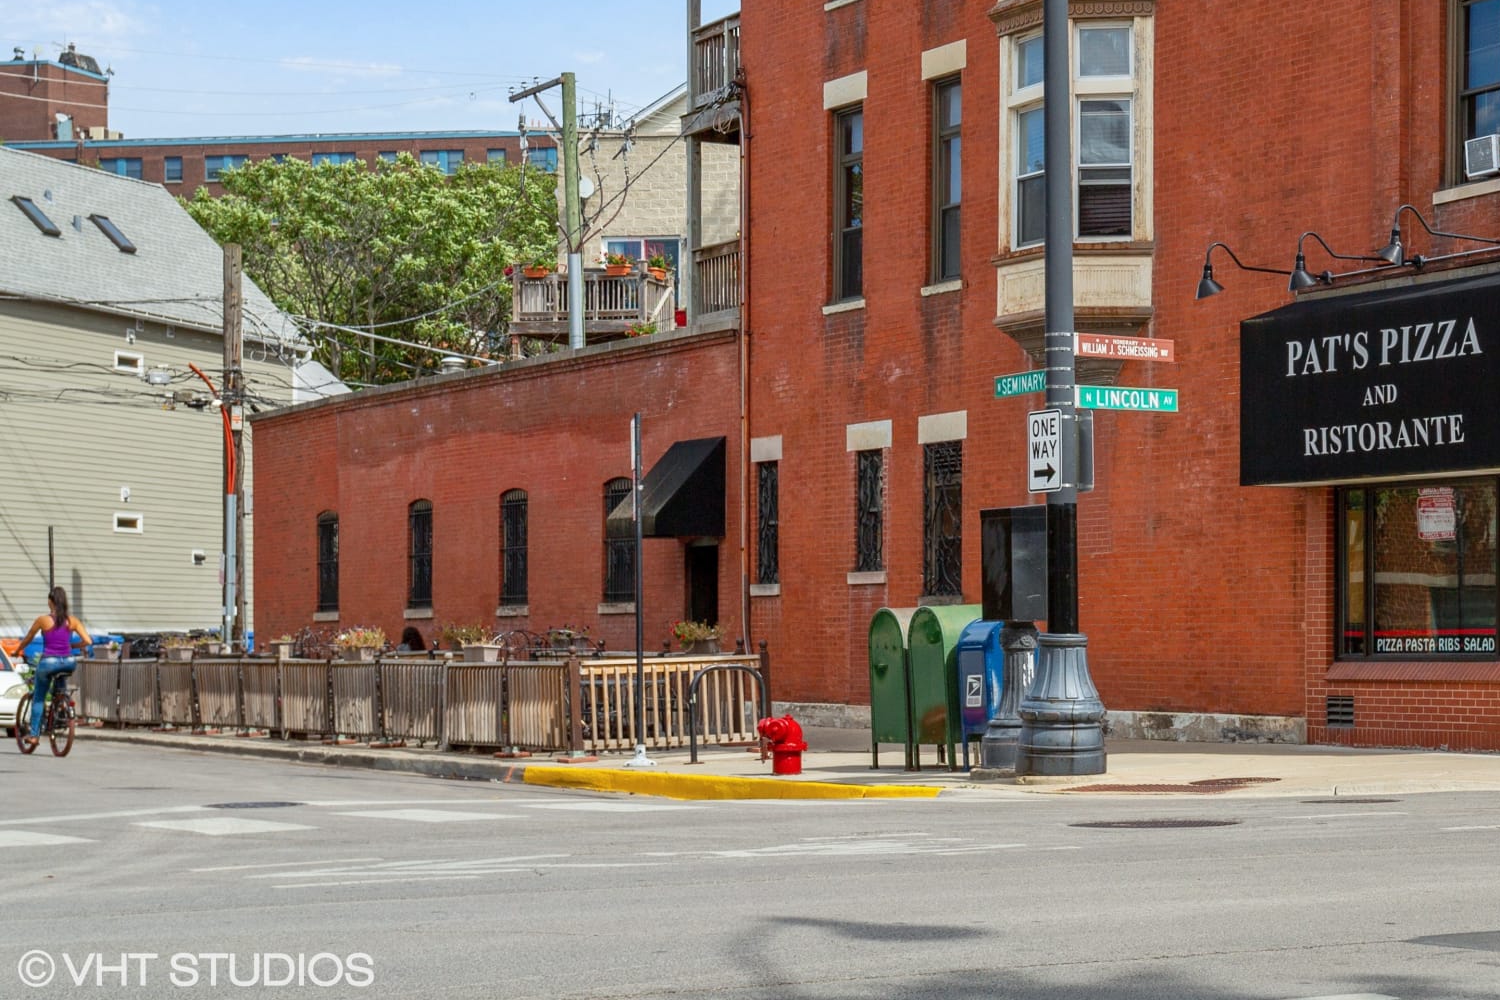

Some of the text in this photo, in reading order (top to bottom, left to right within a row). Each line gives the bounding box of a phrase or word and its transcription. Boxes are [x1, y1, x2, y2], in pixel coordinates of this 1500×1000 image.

[1082, 342, 1107, 354] WILLIAM
[1117, 345, 1158, 358] SCHMEISSING
[1285, 316, 1483, 377] PAT'S PIZZA
[1001, 373, 1045, 395] SEMINARY
[1085, 389, 1173, 409] N LINCOLN AV
[1362, 383, 1398, 406] AND
[1032, 418, 1057, 437] ONE
[1303, 414, 1465, 456] RISTORANTE
[1032, 440, 1057, 459] WAY
[1377, 638, 1496, 652] PIZZA PASTA RIBS SALAD
